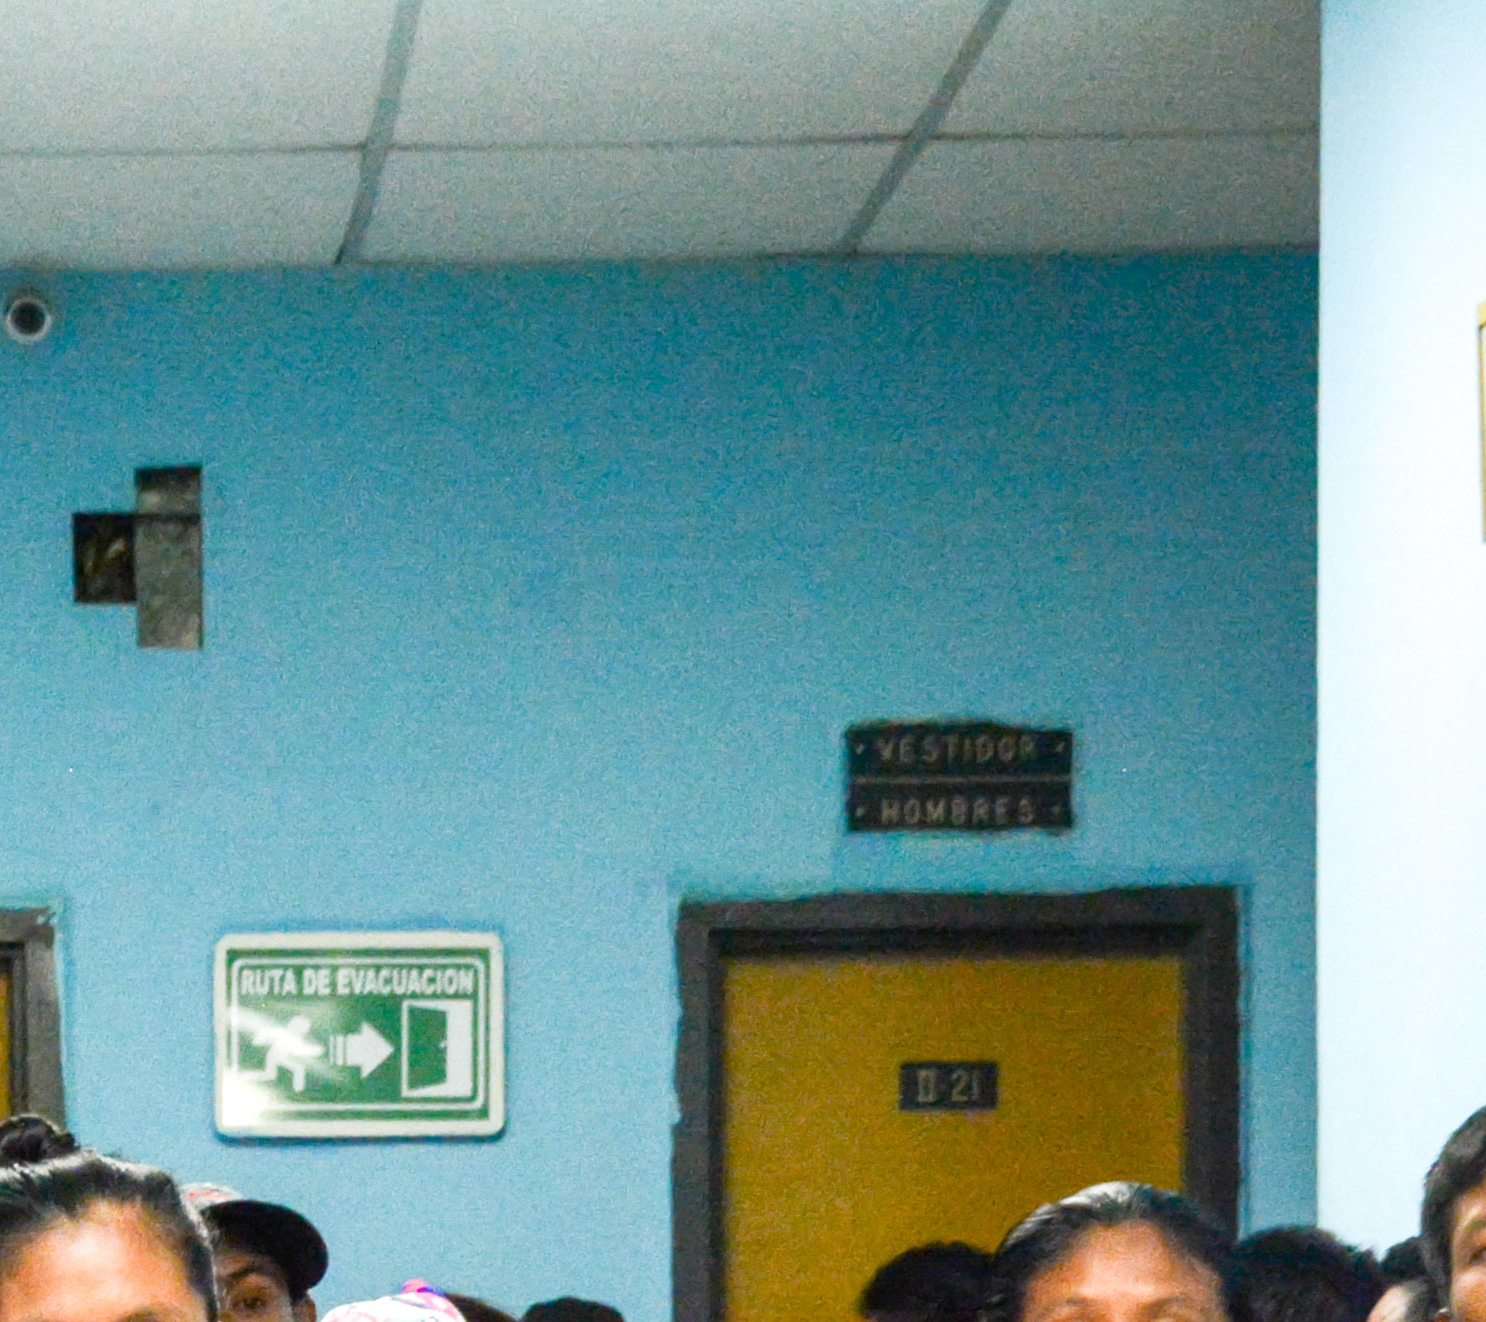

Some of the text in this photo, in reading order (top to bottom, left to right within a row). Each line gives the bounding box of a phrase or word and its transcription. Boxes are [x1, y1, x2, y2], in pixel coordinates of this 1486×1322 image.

[877, 733, 1035, 763] VESTIDOR
[880, 796, 1035, 825] HOMBRES
[240, 967, 474, 996] RUTA DE EVACUACION
